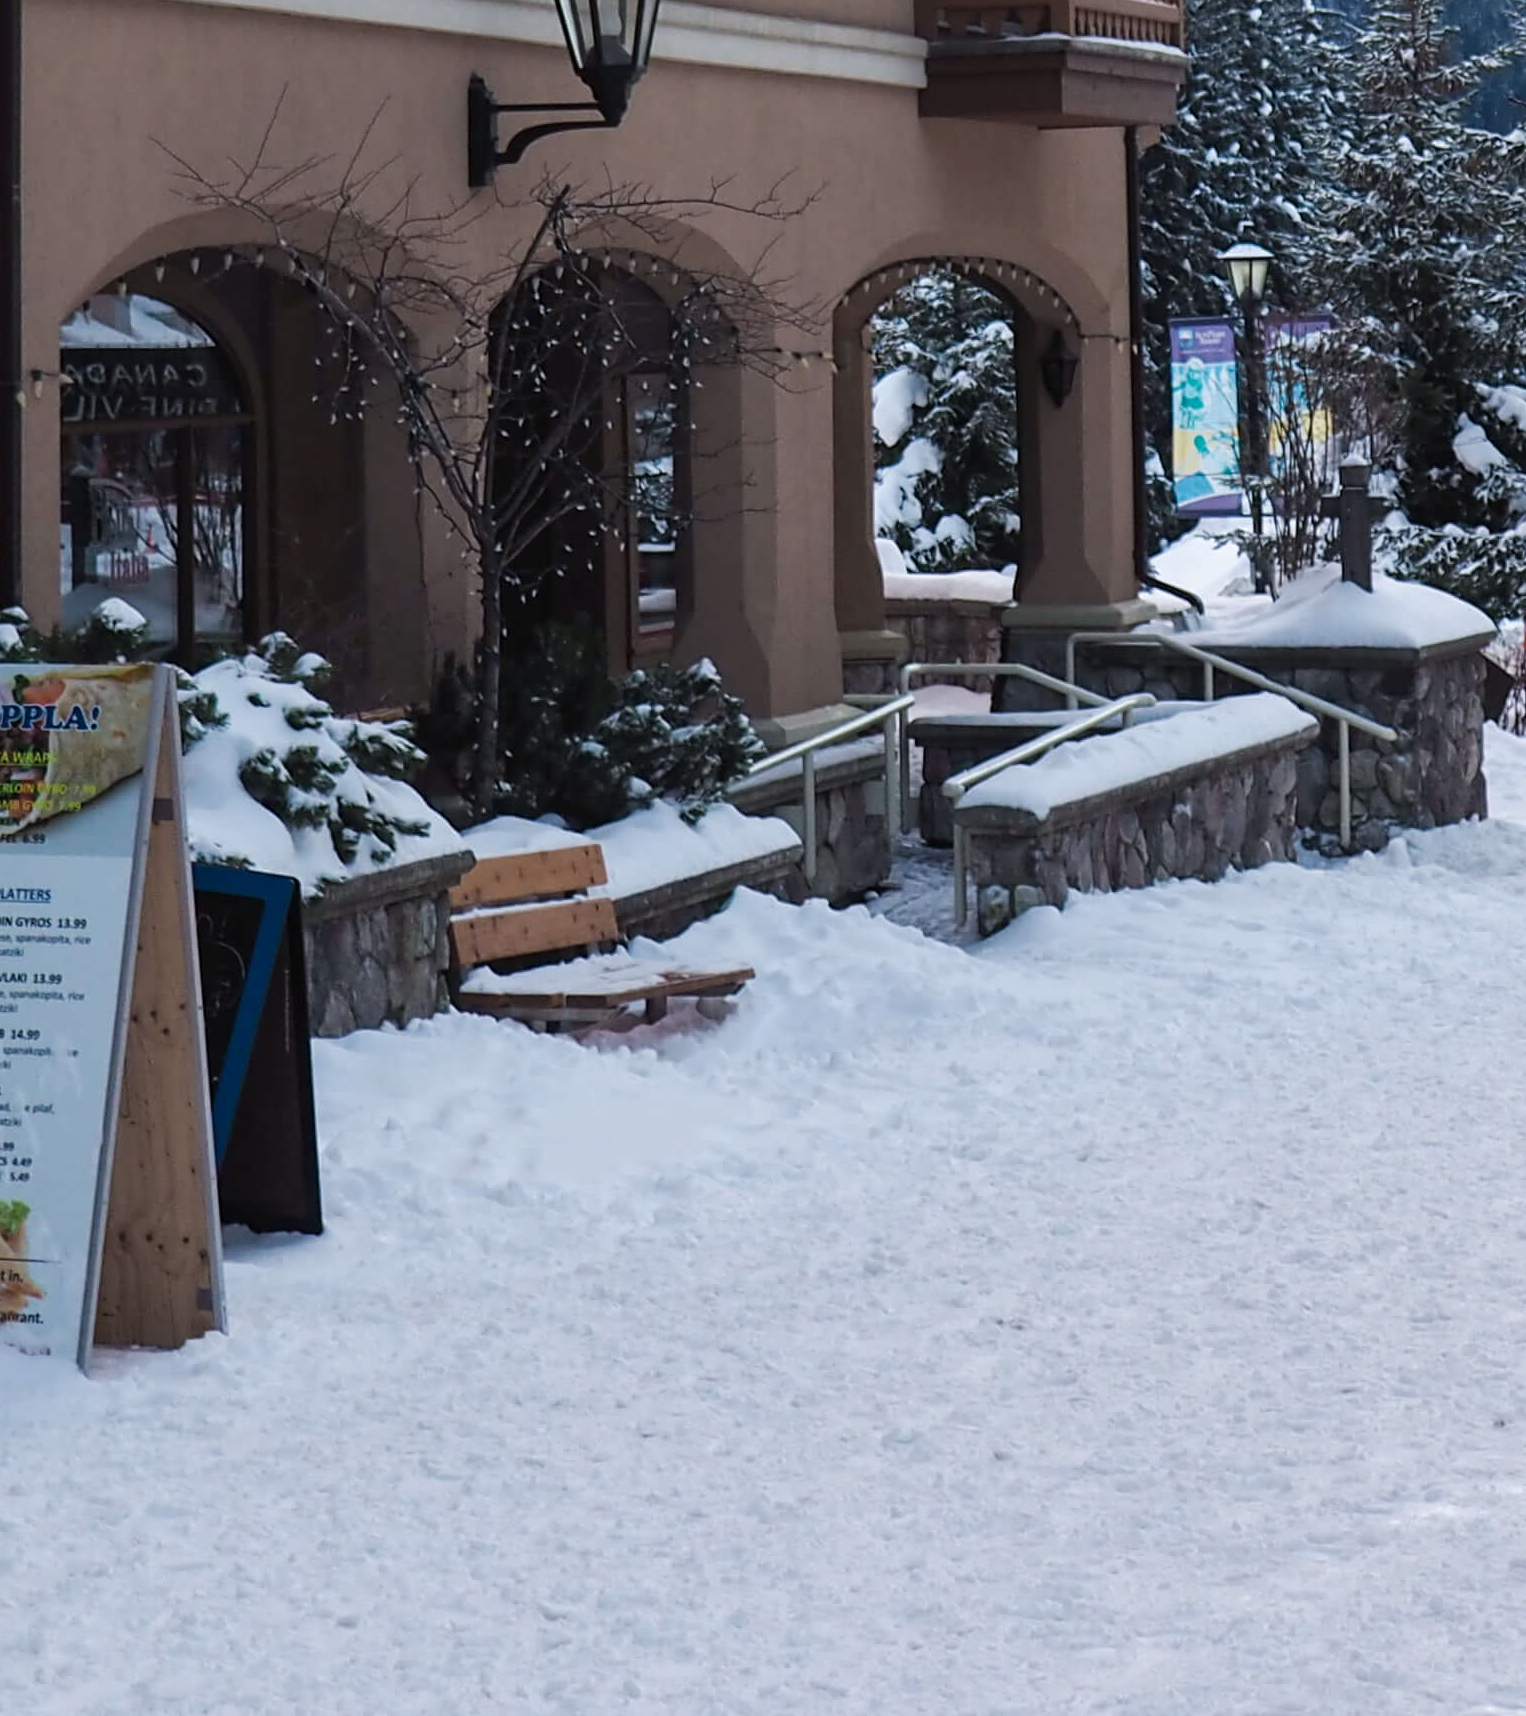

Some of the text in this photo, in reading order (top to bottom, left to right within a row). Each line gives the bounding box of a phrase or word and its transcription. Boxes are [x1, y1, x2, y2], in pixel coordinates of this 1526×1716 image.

[15, 916, 52, 928] GYROS
[57, 918, 87, 929] 13.99
[33, 973, 63, 985] 13.99
[10, 1029, 41, 1041] 14.99
[8, 1269, 25, 1283] in.
